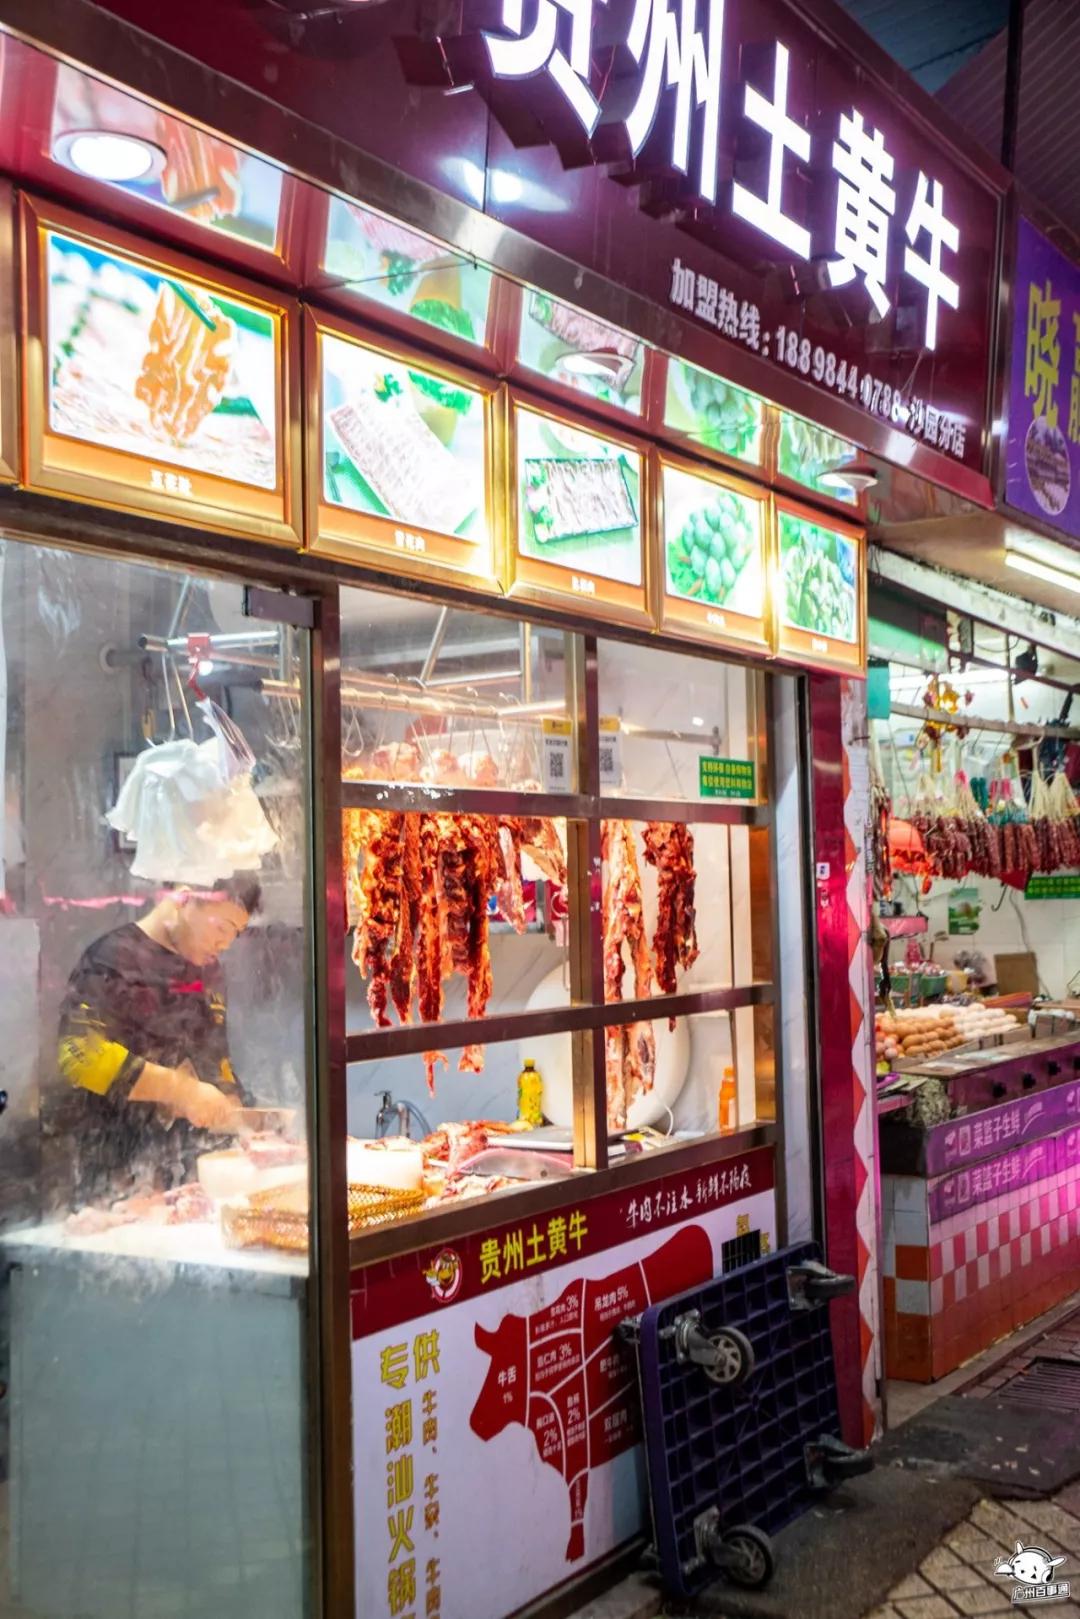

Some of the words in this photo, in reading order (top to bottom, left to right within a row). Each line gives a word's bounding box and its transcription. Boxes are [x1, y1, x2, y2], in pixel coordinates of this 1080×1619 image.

[626, 1184, 694, 1230] 牛肉不注水
[479, 1209, 589, 1285] 贵州土黄牛
[379, 1328, 441, 1391] 专供
[384, 1398, 417, 1619] 潮汕火锅
